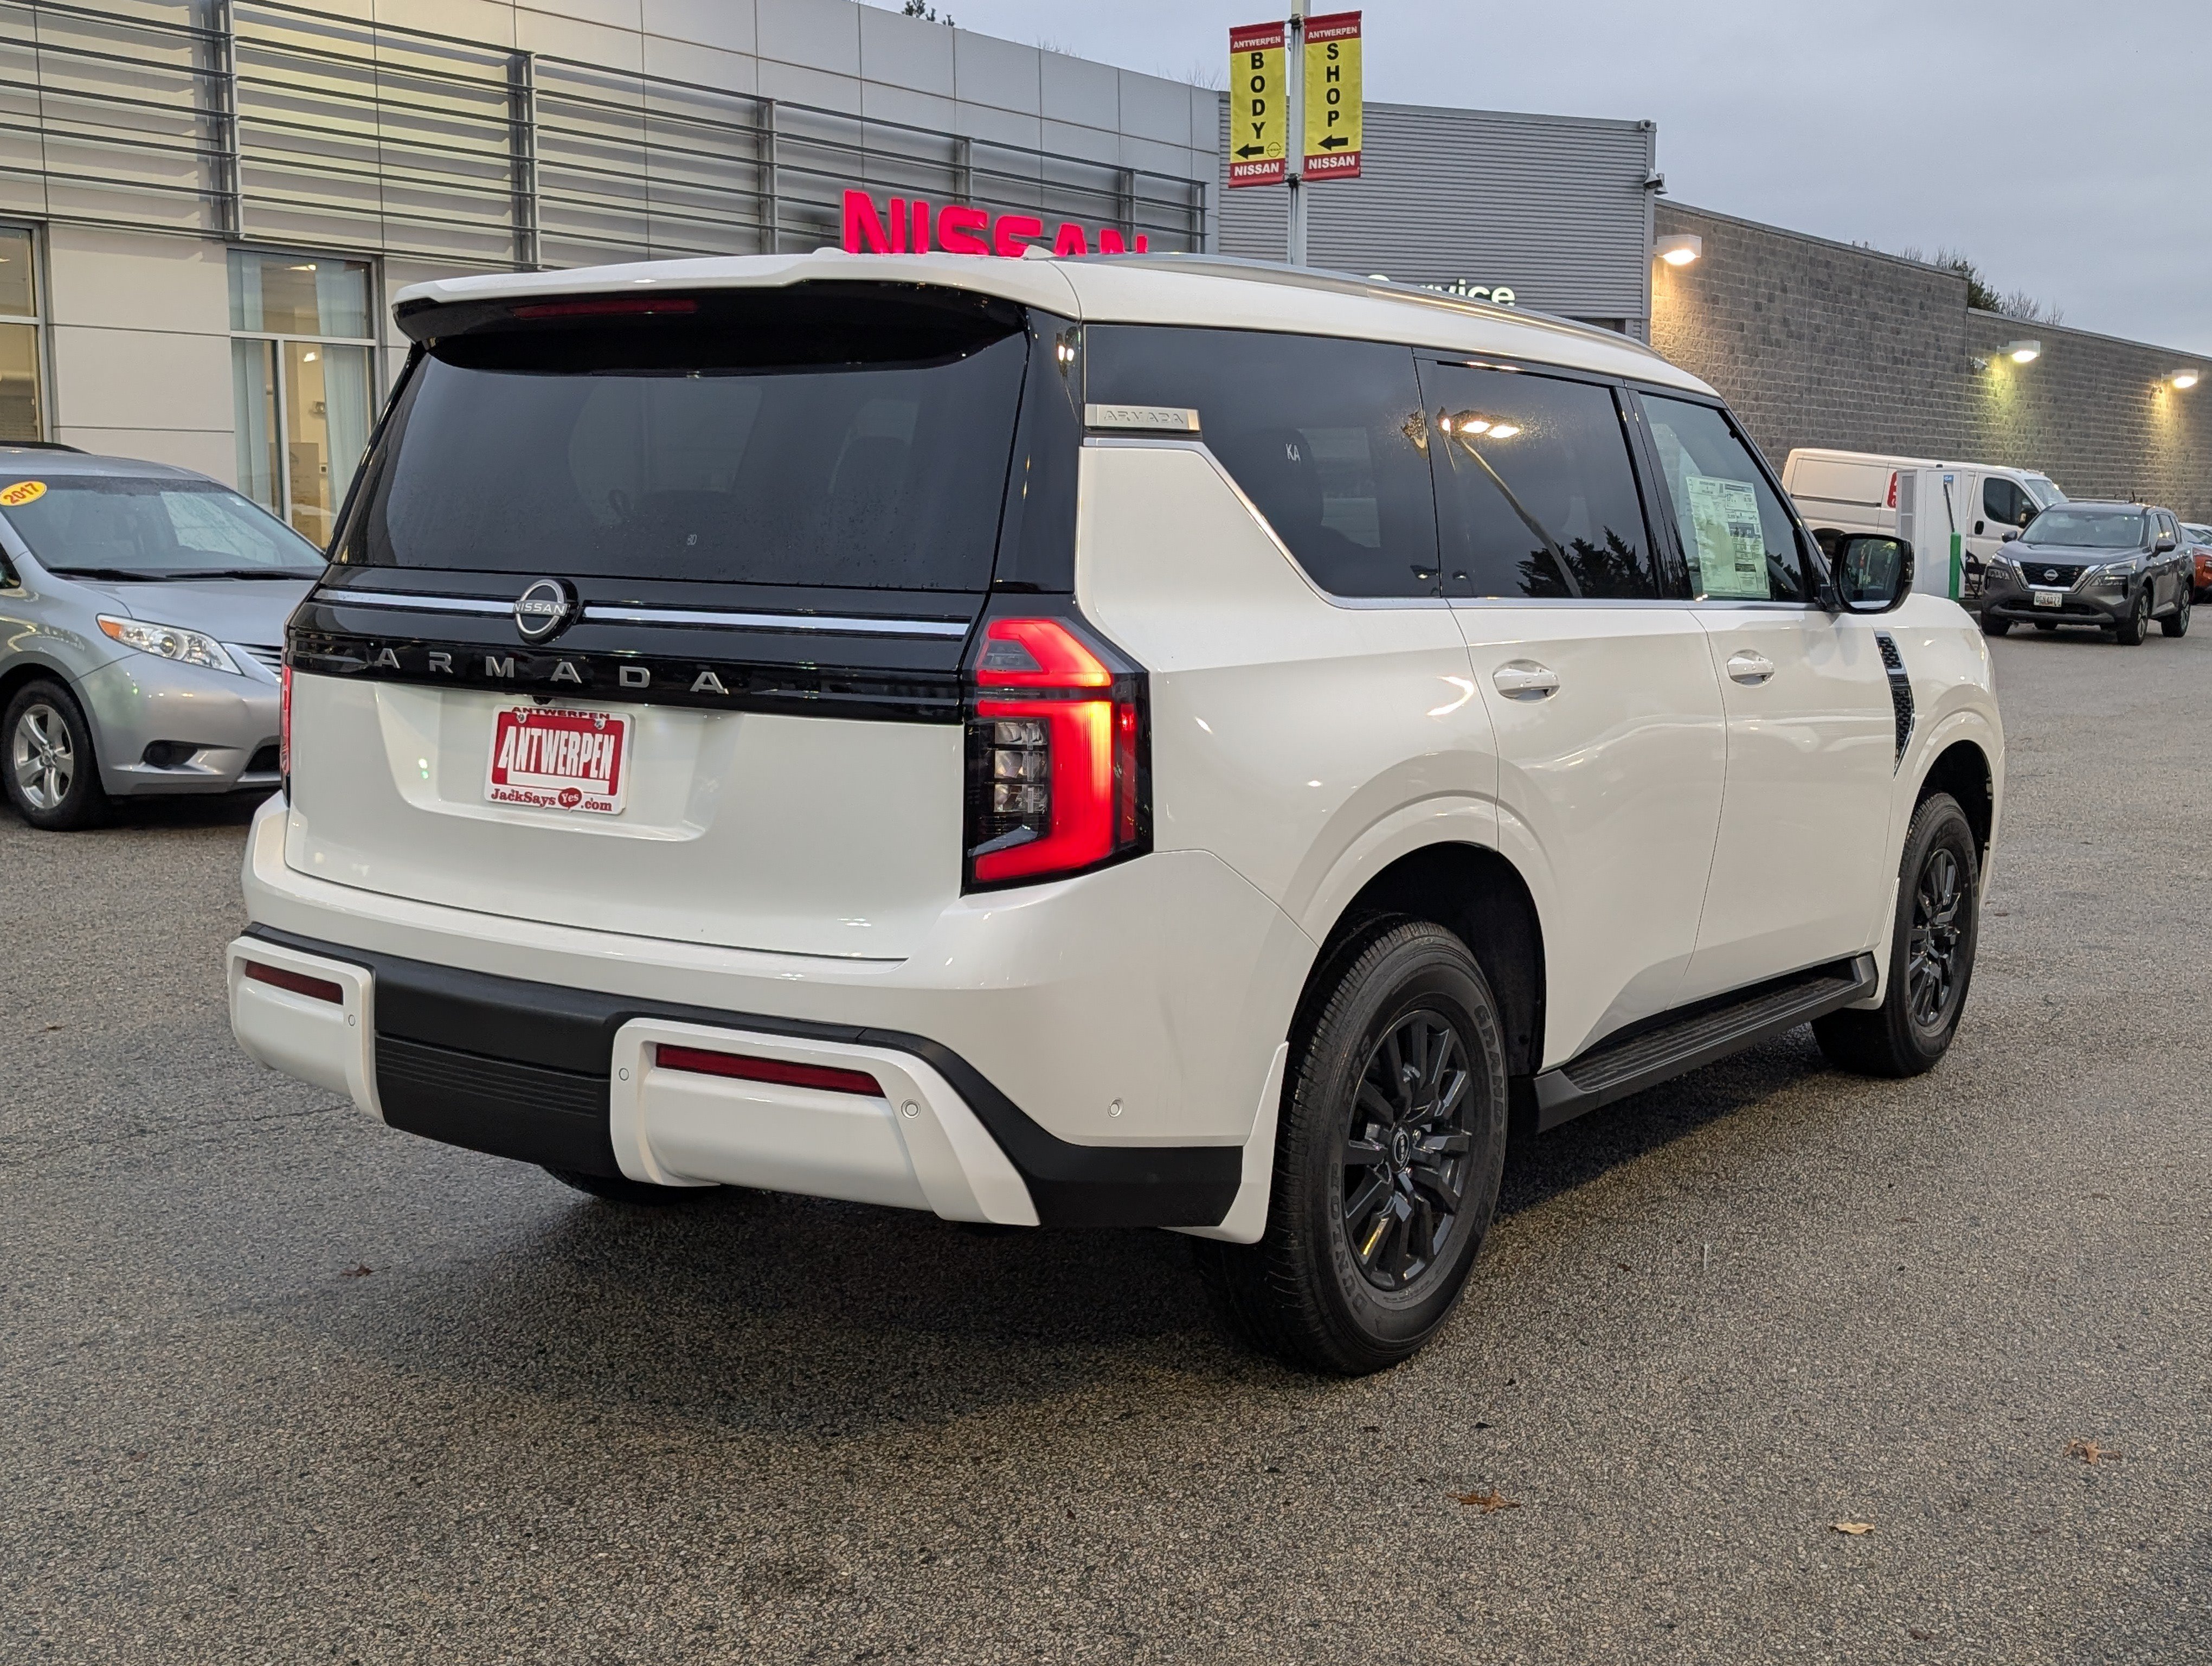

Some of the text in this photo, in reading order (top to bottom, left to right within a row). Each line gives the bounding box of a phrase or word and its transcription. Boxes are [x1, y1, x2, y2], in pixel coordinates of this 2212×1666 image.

[1308, 26, 1358, 39] ANTWERPEN
[1233, 35, 1281, 49] ANTWERPEN
[1326, 42, 1340, 127] SHOP
[1250, 52, 1266, 139] BODY
[1234, 162, 1279, 176] NISSAN
[1308, 155, 1355, 170] NISSAN
[1104, 411, 1184, 424] ARMADA
[3, 483, 38, 504] 2017
[513, 601, 565, 614] NISSAN
[376, 648, 729, 695] ARMADA
[511, 706, 610, 720] ANTWERPEN
[497, 726, 616, 795] ANTWERPEN
